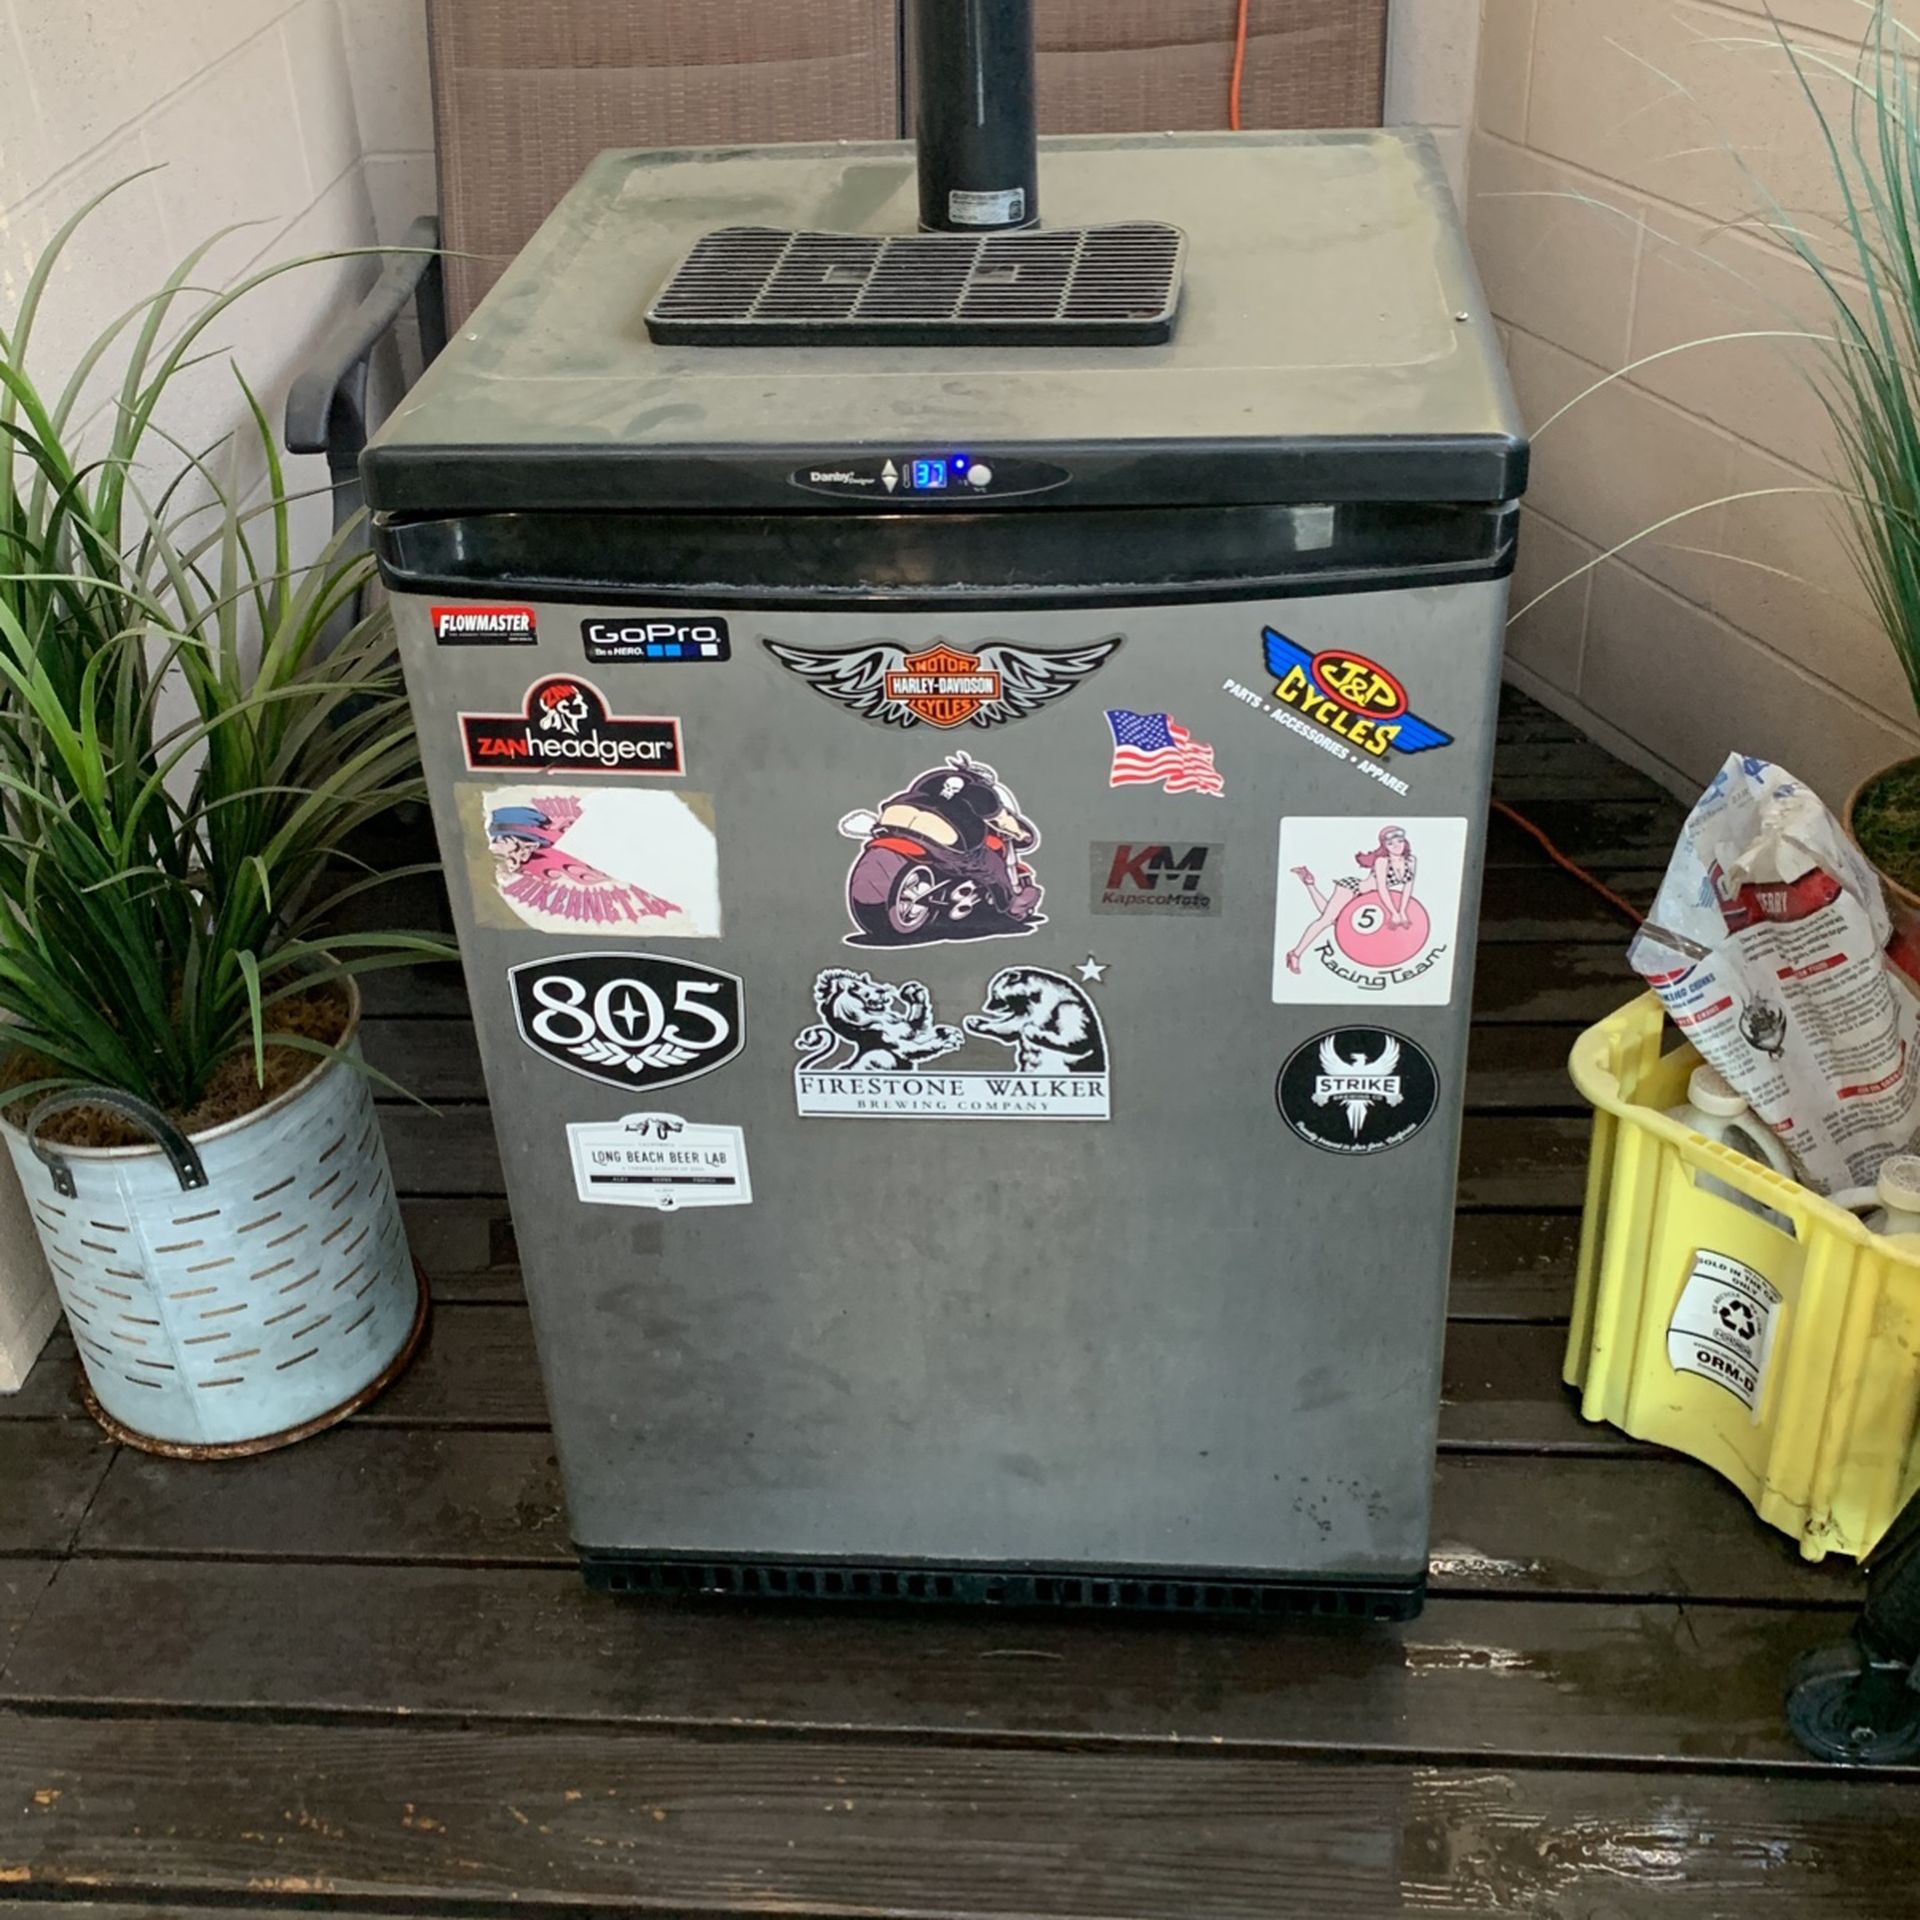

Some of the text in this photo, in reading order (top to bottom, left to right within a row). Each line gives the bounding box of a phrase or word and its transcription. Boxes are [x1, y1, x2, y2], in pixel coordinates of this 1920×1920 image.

[810, 471, 850, 484] Danby
[916, 462, 945, 485] 37
[439, 614, 530, 638] FLOWMASTER
[916, 657, 970, 673] MOTOR
[893, 677, 994, 694] HARLEY-DAVIDSON
[1320, 661, 1397, 707] J&P
[918, 699, 971, 719] CYCLES
[1275, 664, 1402, 757] CYCLES
[1222, 679, 1411, 797] PARTS ACCESSORIES APPAREL
[1106, 845, 1209, 890] KM
[1102, 892, 1211, 907] KapscoMoto
[1357, 908, 1377, 928] 5
[1314, 939, 1448, 991] Racing Team
[532, 976, 730, 1050] 805
[800, 1077, 1105, 1098] FIRESTONE WALKER
[1320, 1078, 1396, 1093] STRIKE
[857, 1100, 1050, 1112] BREWING COMPANY
[592, 1151, 727, 1168] LONG BEACH BEER LAB
[1696, 1350, 1755, 1393] ORM-D
